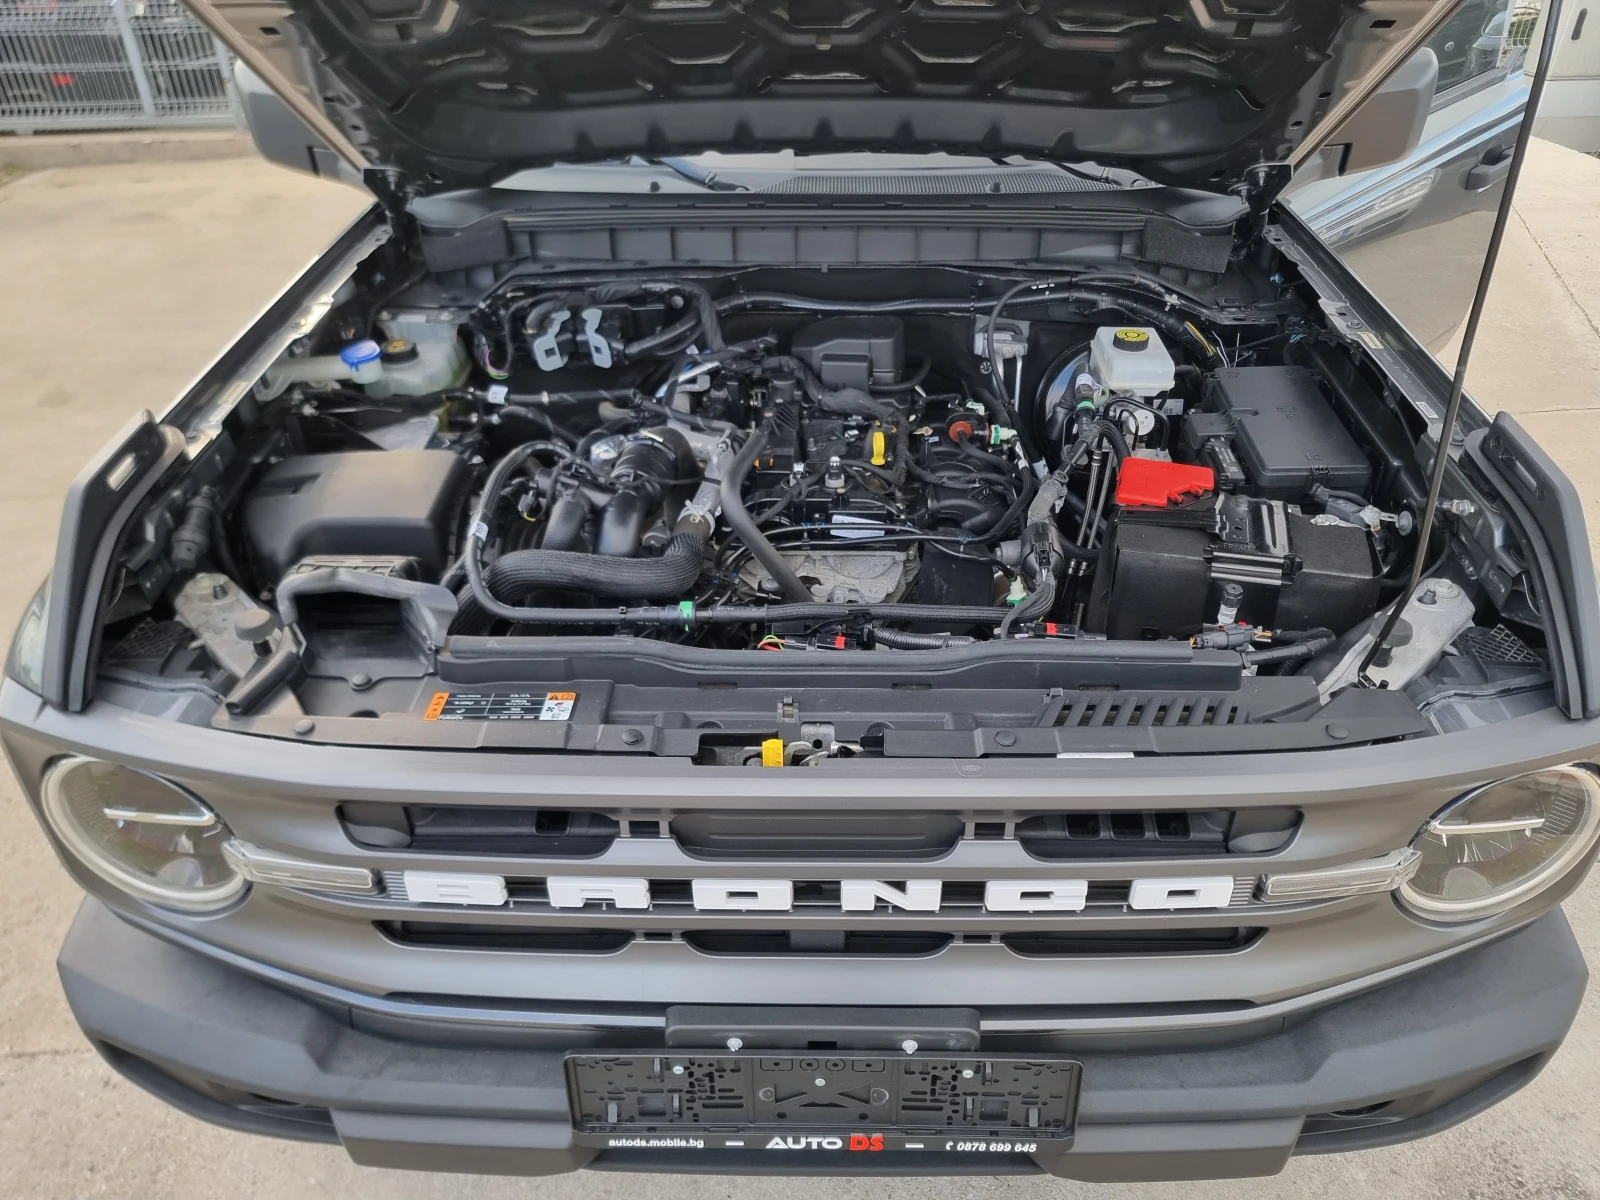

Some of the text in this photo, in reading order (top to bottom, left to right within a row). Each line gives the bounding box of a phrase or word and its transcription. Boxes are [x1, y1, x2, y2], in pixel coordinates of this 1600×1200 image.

[404, 871, 1234, 912] BRONCO
[608, 1133, 1037, 1153] autods.mobile.bg AUTO DS 0878 699 645
